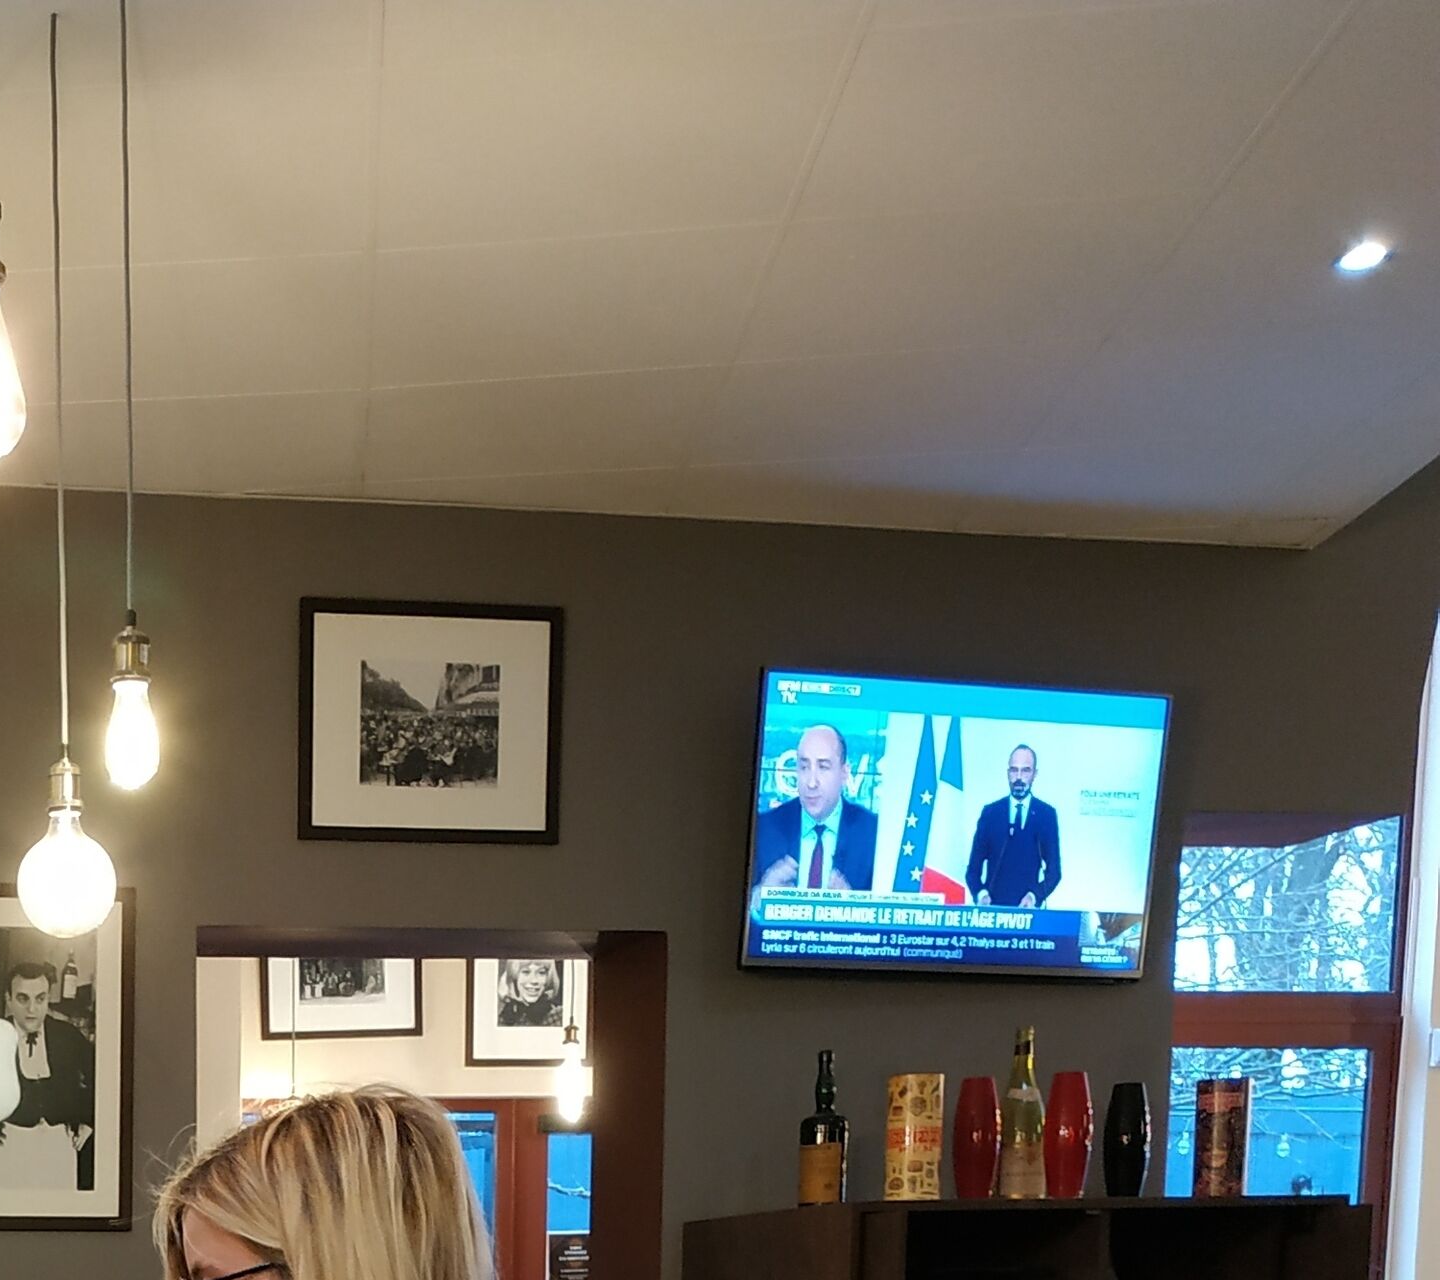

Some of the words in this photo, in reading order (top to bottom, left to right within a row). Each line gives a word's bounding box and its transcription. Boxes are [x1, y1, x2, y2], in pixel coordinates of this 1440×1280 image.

[764, 903, 813, 921] BERGER
[814, 905, 877, 924] DEMANDE
[877, 908, 892, 924] LE
[892, 909, 945, 927] RETRAIT
[945, 911, 960, 927] DE
[961, 908, 995, 929] L'ÂGE
[996, 913, 1034, 930] PIVOT
[783, 943, 798, 953] sur
[806, 943, 854, 955] circuleront
[854, 944, 901, 957] aujourd'hui
[889, 934, 897, 944] 3
[897, 935, 935, 946] Eurostar
[935, 937, 950, 946] sur
[968, 936, 995, 950] Thalys
[996, 940, 1011, 949] sur
[1018, 939, 1029, 949] et
[1035, 938, 1056, 950] train
